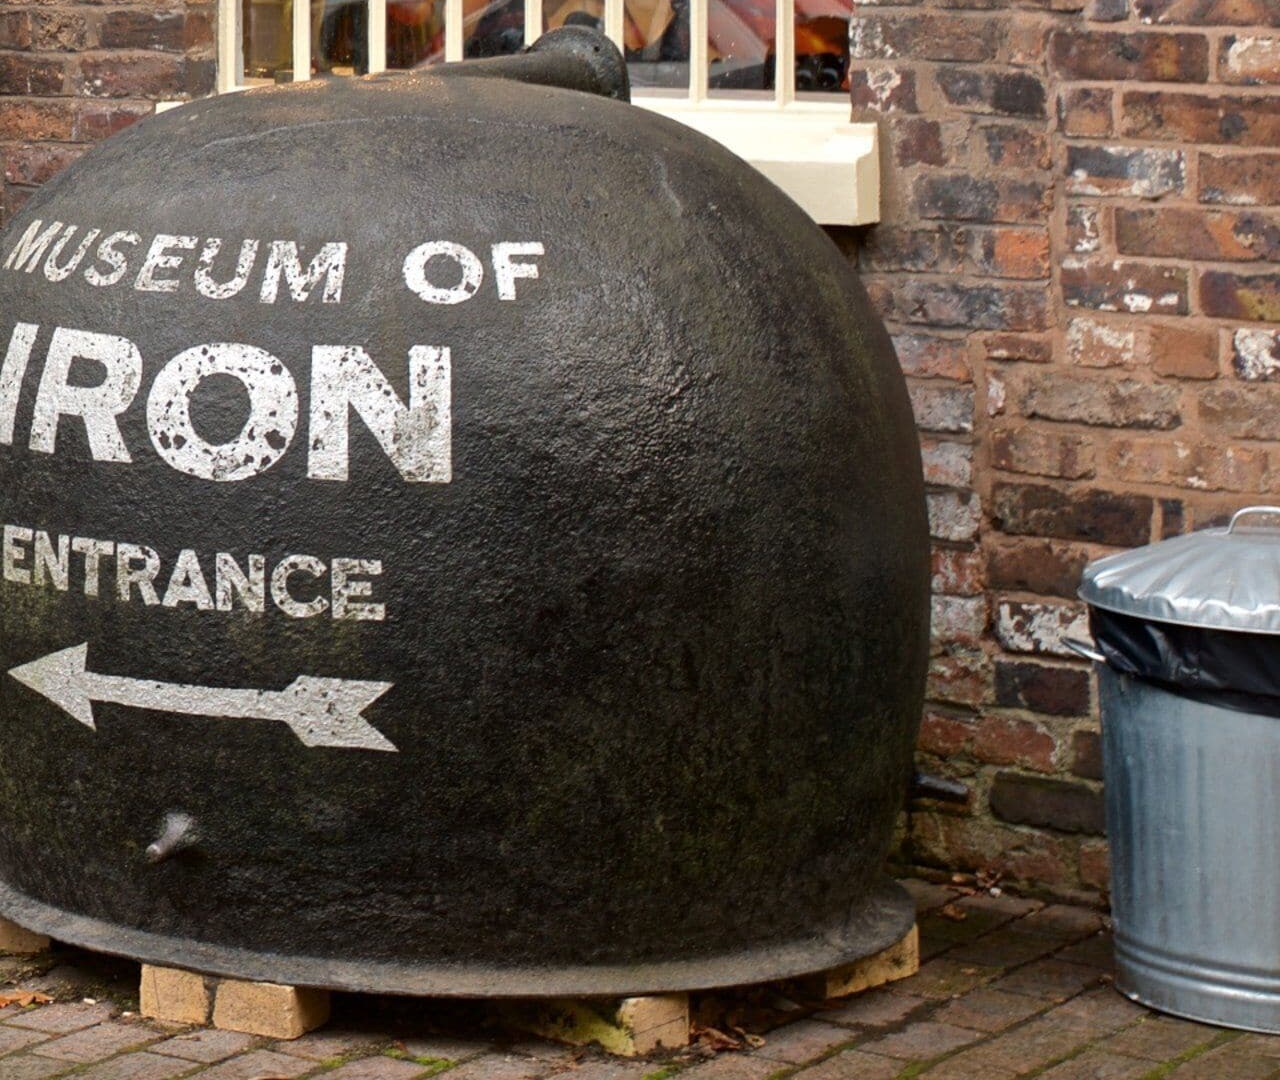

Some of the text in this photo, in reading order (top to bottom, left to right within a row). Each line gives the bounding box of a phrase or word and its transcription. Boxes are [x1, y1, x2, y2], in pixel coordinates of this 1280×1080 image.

[2, 219, 545, 305] MUSEUM OF
[1, 523, 386, 621] ENTRANCE
